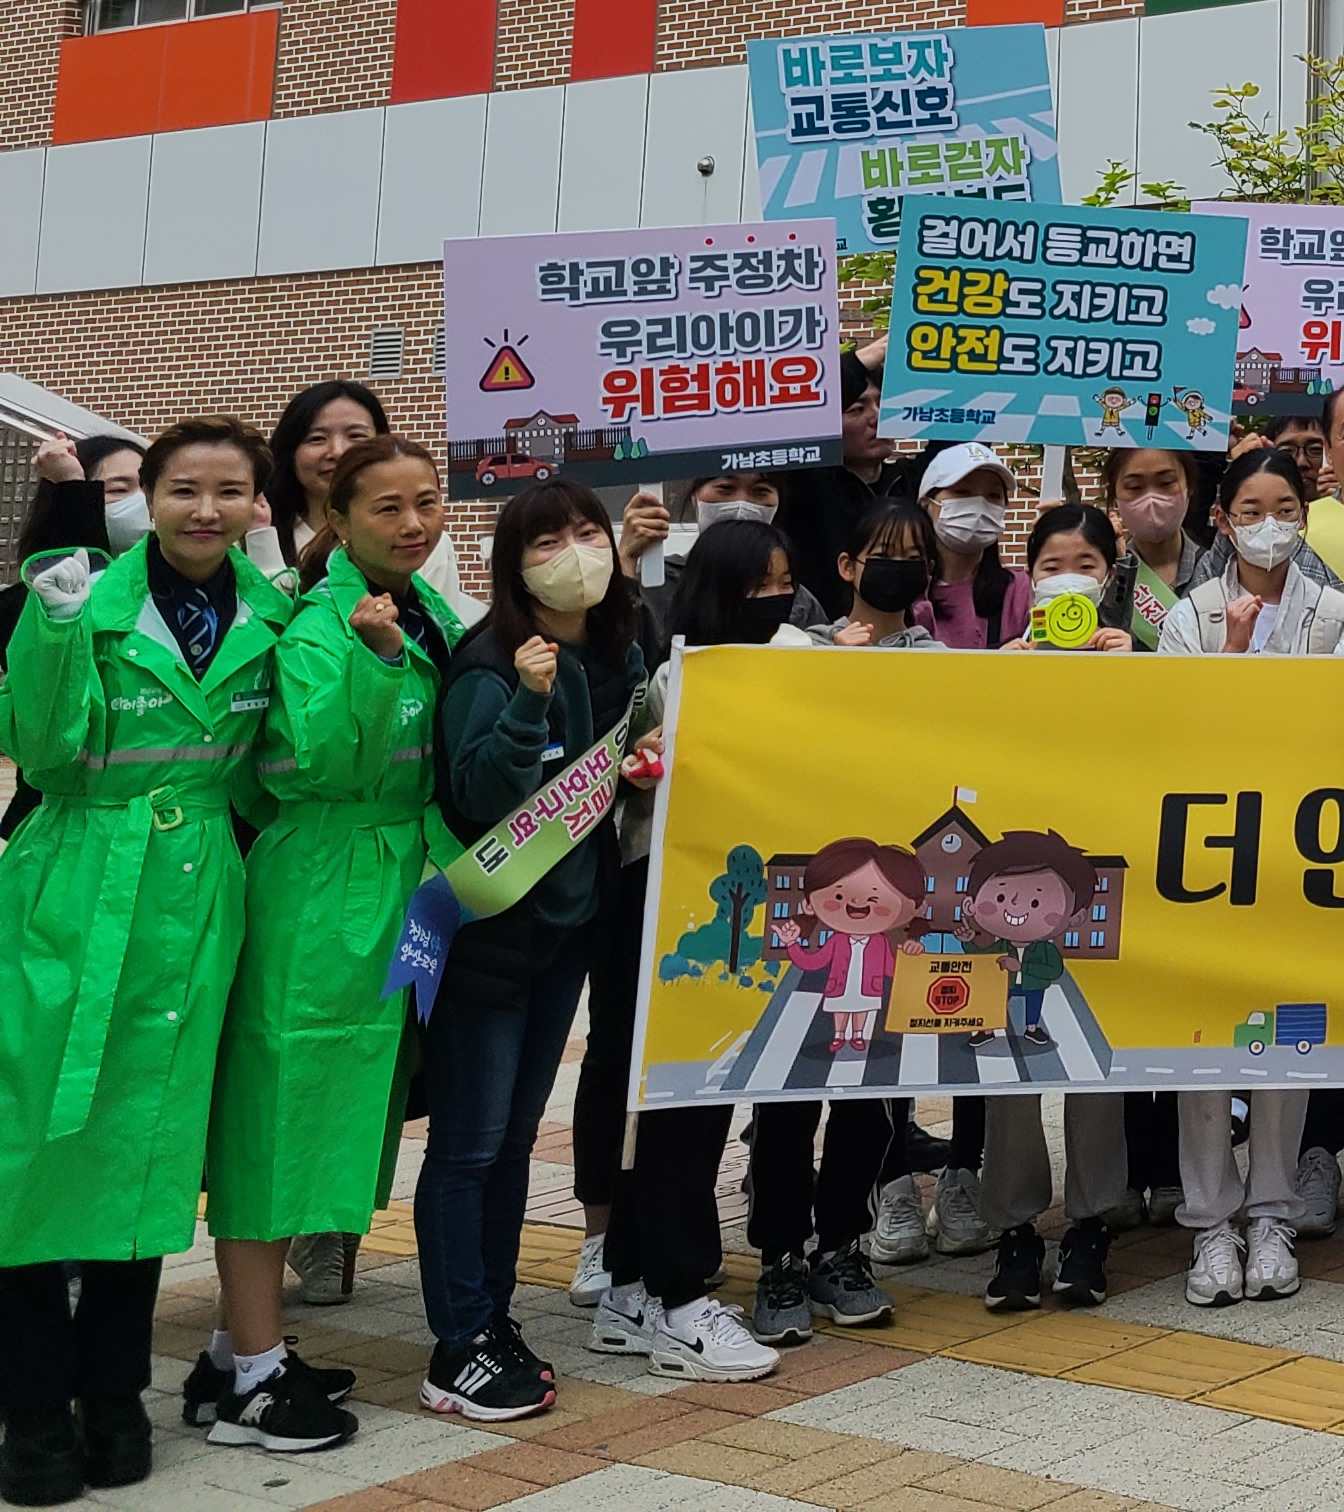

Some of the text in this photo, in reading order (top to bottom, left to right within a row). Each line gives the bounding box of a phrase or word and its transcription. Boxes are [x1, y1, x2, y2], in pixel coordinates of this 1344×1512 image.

[781, 38, 952, 86] 바로보자
[789, 87, 955, 138] 교통신호
[862, 138, 1027, 189] 바로걷자
[921, 218, 1194, 271] 걸어서 등교하면
[539, 247, 822, 299] 학교앞 주정차
[916, 269, 1165, 324] 건강도 지키고
[600, 303, 823, 358] 우리아이가
[911, 325, 1160, 379] 안전도 지키고
[603, 357, 821, 419] 위험해요
[902, 405, 996, 426] 가남초등학교
[721, 447, 821, 471] 가남초등학교
[508, 746, 613, 847] 보호구역
[1156, 790, 1262, 906] 더
[935, 996, 959, 1005] STOP
